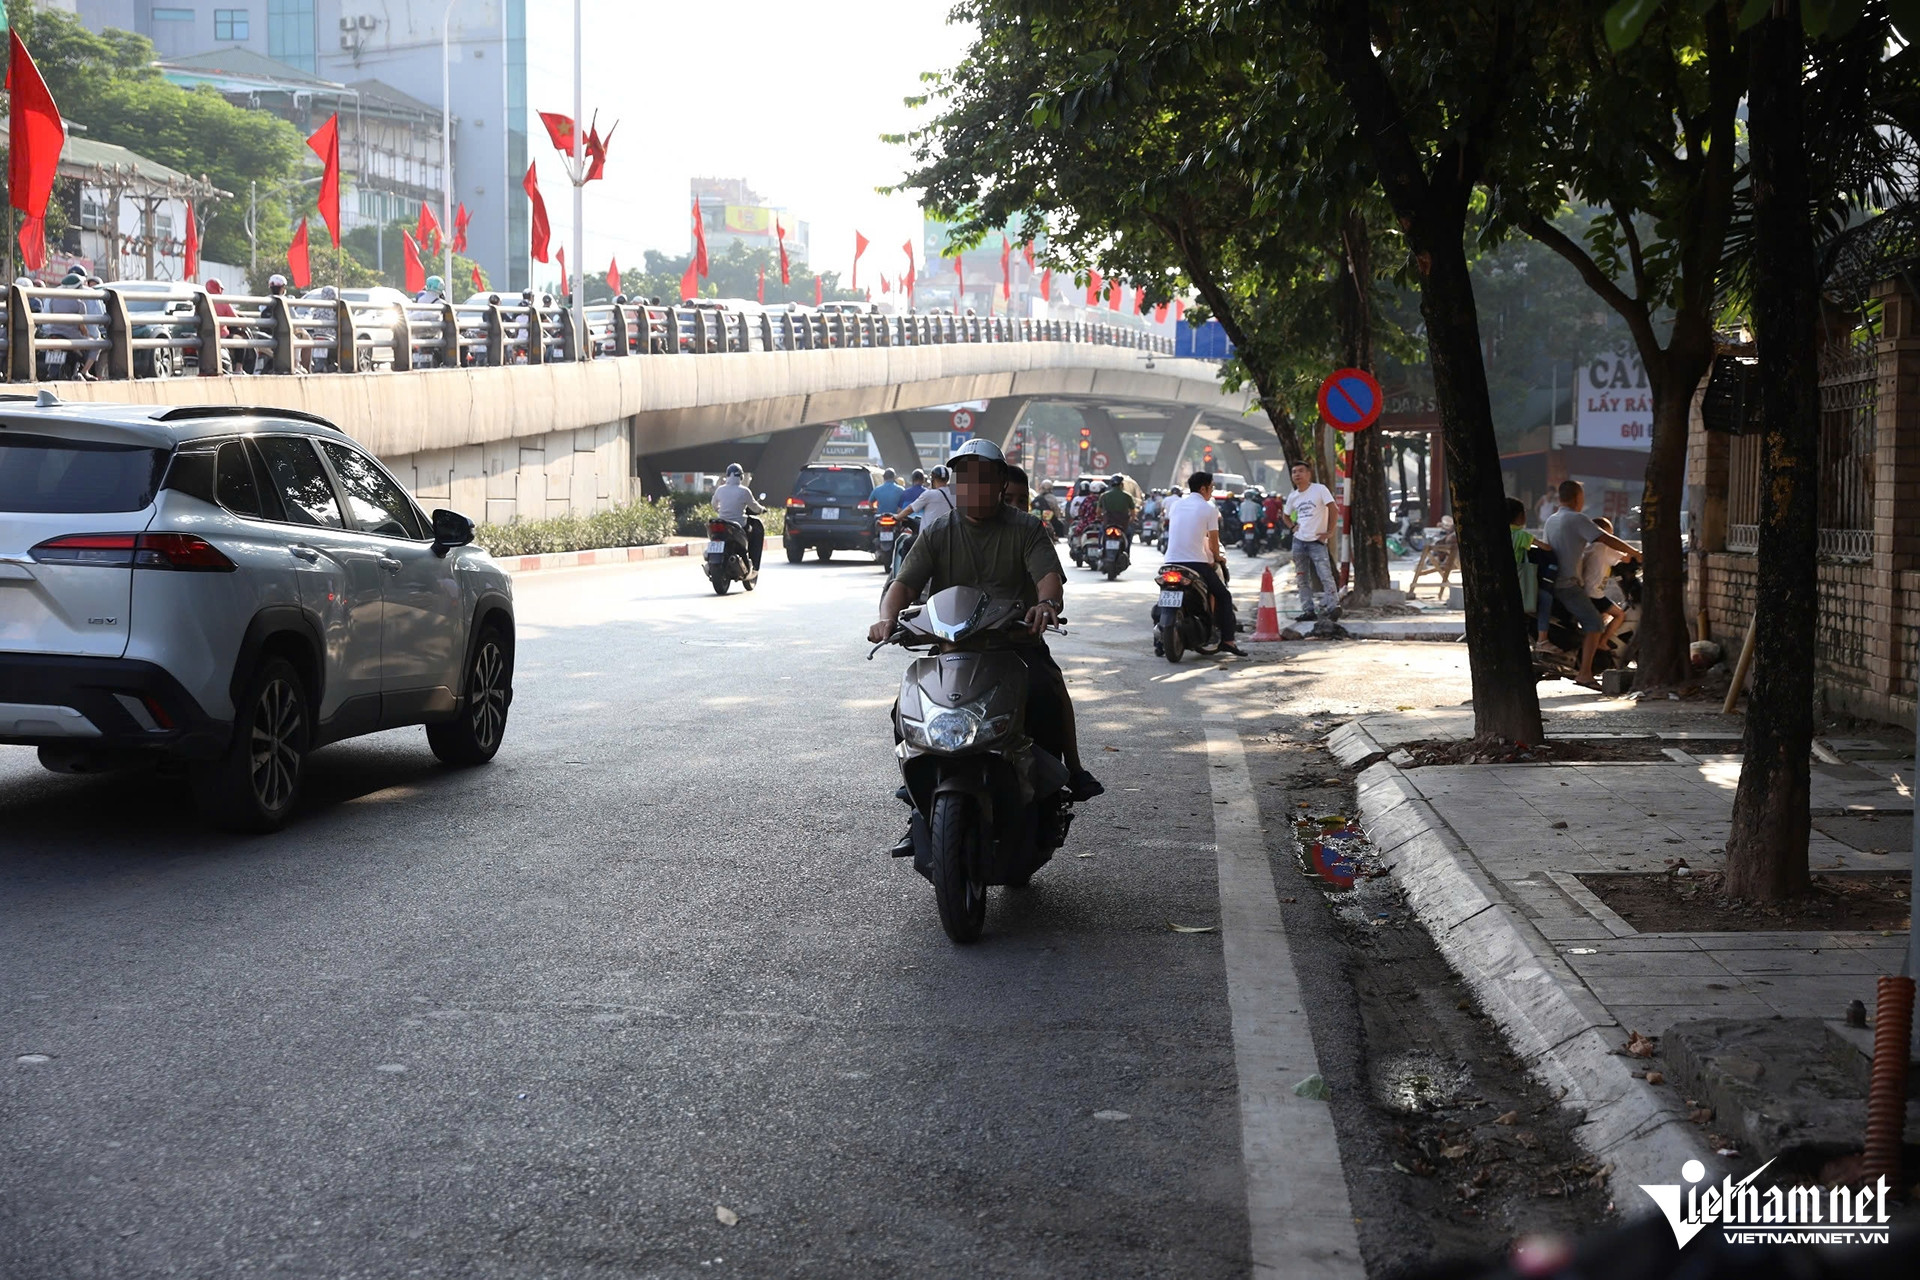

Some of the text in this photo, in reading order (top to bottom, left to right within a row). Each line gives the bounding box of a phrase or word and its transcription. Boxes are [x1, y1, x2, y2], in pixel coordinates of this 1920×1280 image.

[1588, 391, 1620, 413] LẤY
[1621, 421, 1644, 440] GỘI
[826, 447, 855, 455] LUXURY
